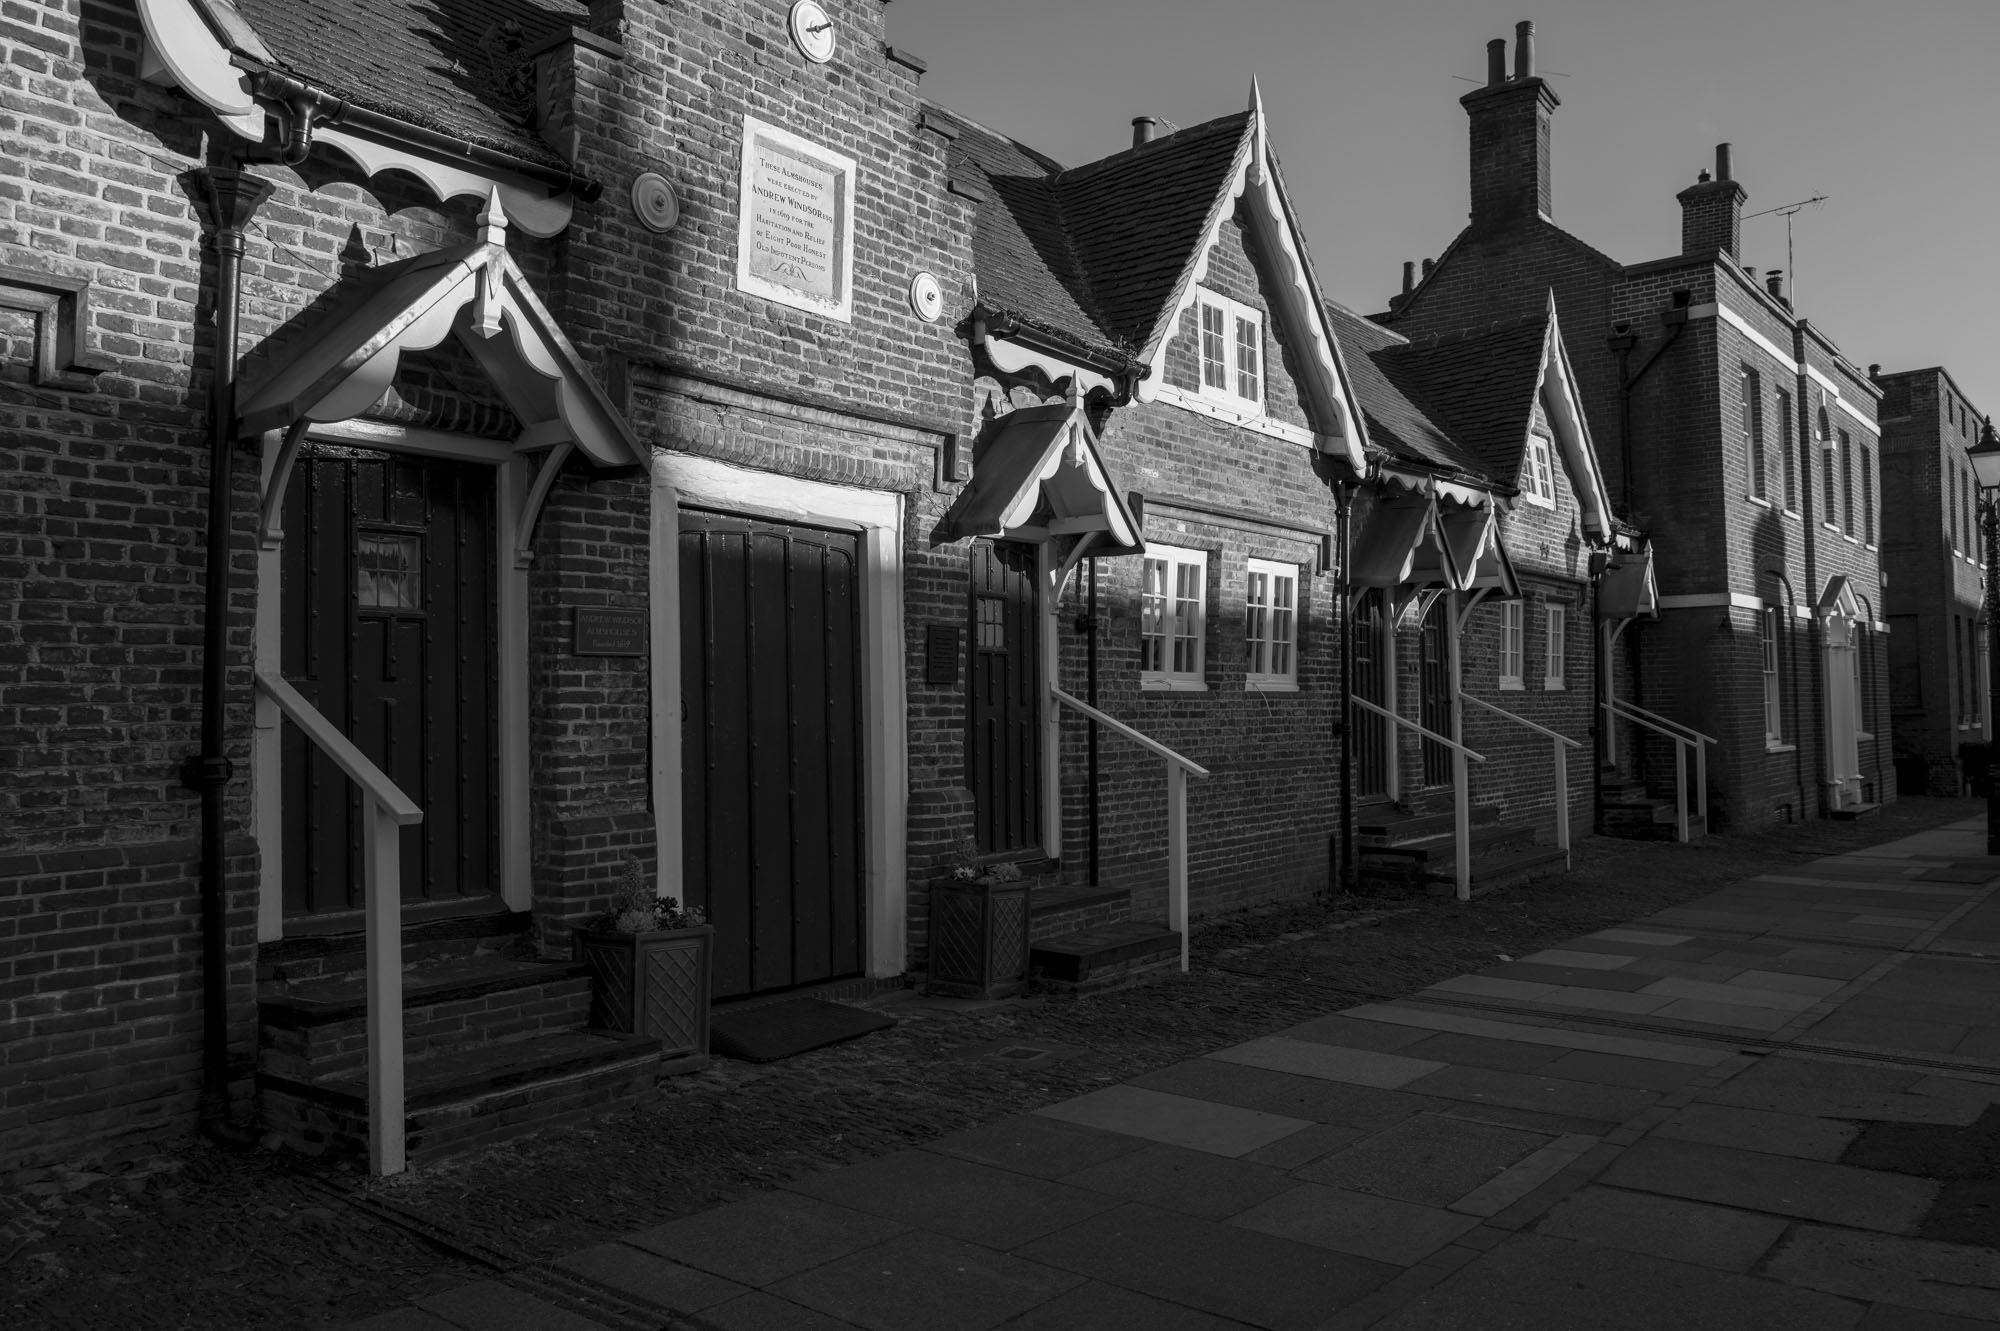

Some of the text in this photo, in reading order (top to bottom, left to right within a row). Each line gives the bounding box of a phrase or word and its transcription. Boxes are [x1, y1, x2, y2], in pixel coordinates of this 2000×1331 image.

[760, 158, 823, 190] THESE ALMSHOUSES
[767, 177, 782, 188] WERE
[784, 184, 810, 198] ERECTED
[752, 184, 786, 204] ANDREW
[788, 197, 822, 218] WINDSOR
[757, 213, 825, 245] HABITATION AND RELIEF
[792, 216, 804, 225] FOR
[804, 220, 815, 229] THE
[757, 241, 769, 253] OLD
[801, 256, 826, 272] PERSONS
[766, 231, 784, 244] EIGHT
[786, 238, 802, 251] POOR
[803, 244, 826, 259] HONEST
